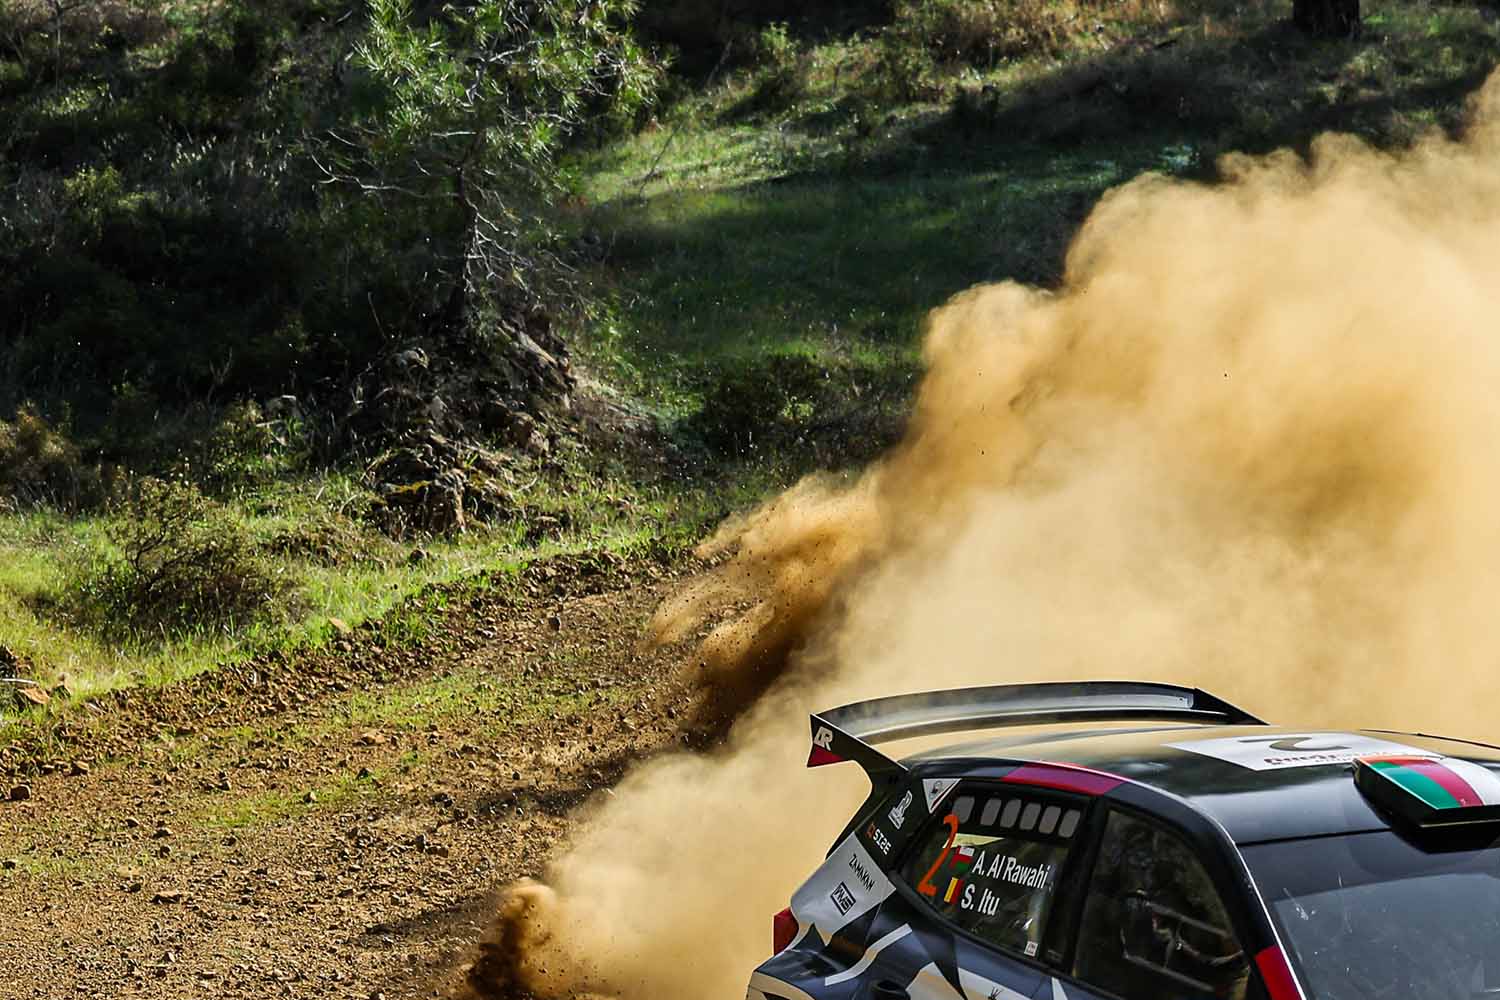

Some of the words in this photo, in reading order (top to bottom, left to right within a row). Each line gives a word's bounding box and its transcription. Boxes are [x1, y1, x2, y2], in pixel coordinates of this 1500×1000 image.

[916, 813, 960, 898] 2
[972, 850, 986, 876] A.
[987, 853, 1006, 879] Al
[1002, 856, 1051, 890] Rawahi
[960, 883, 976, 911] S.
[977, 887, 1001, 916] Itu
